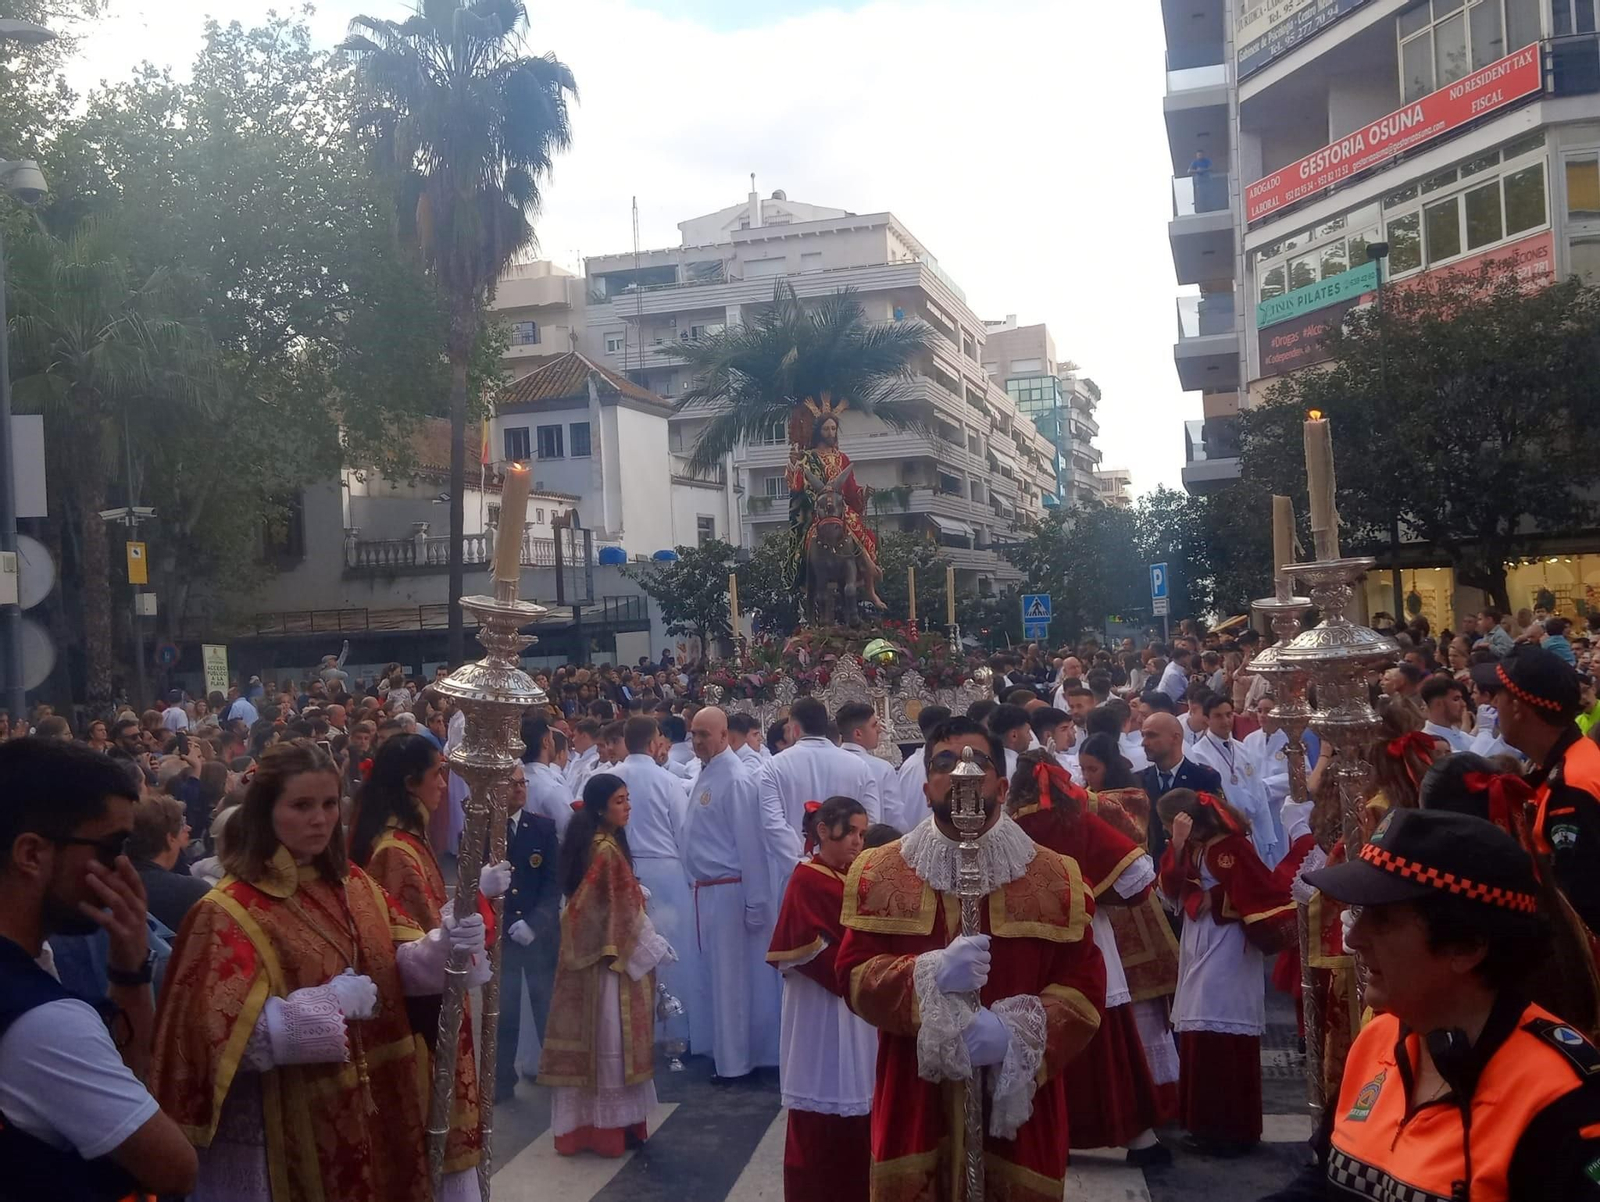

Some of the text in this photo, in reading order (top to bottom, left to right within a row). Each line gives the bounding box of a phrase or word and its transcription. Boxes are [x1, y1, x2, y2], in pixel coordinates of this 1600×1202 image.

[1270, 41, 1283, 55] Tel.
[1285, 31, 1295, 44] 95
[1449, 50, 1533, 101] NO RESIDENT TAX
[1471, 88, 1504, 113] FISCAL
[1300, 104, 1425, 179] GESTORIA OSUNA
[1249, 175, 1281, 199] ABOGADO
[1251, 195, 1280, 216] LABORAL
[1297, 282, 1341, 307] PILATES
[1271, 331, 1300, 348] #Drogas
[1153, 568, 1163, 595] P
